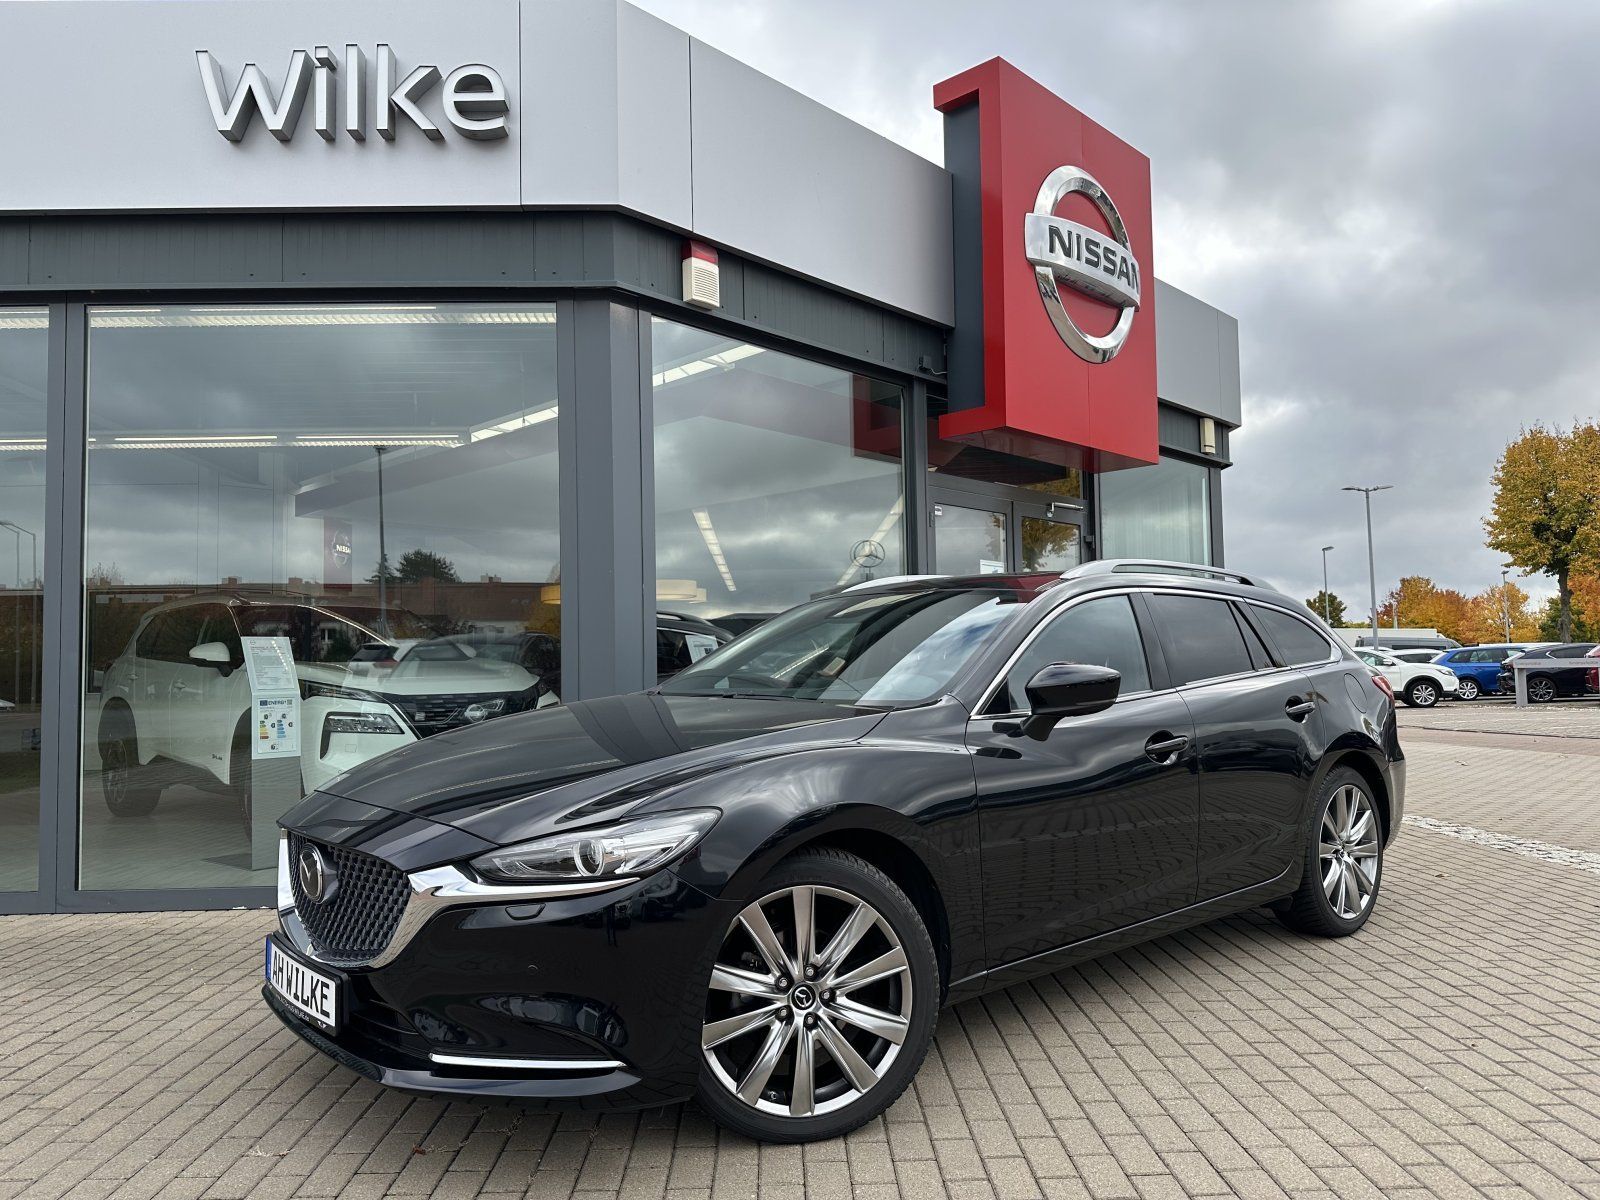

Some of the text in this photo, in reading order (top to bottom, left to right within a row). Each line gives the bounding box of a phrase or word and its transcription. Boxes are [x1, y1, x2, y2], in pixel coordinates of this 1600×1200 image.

[195, 43, 509, 142] Wilke
[272, 950, 284, 990] AH
[286, 960, 331, 1019] WILKE
